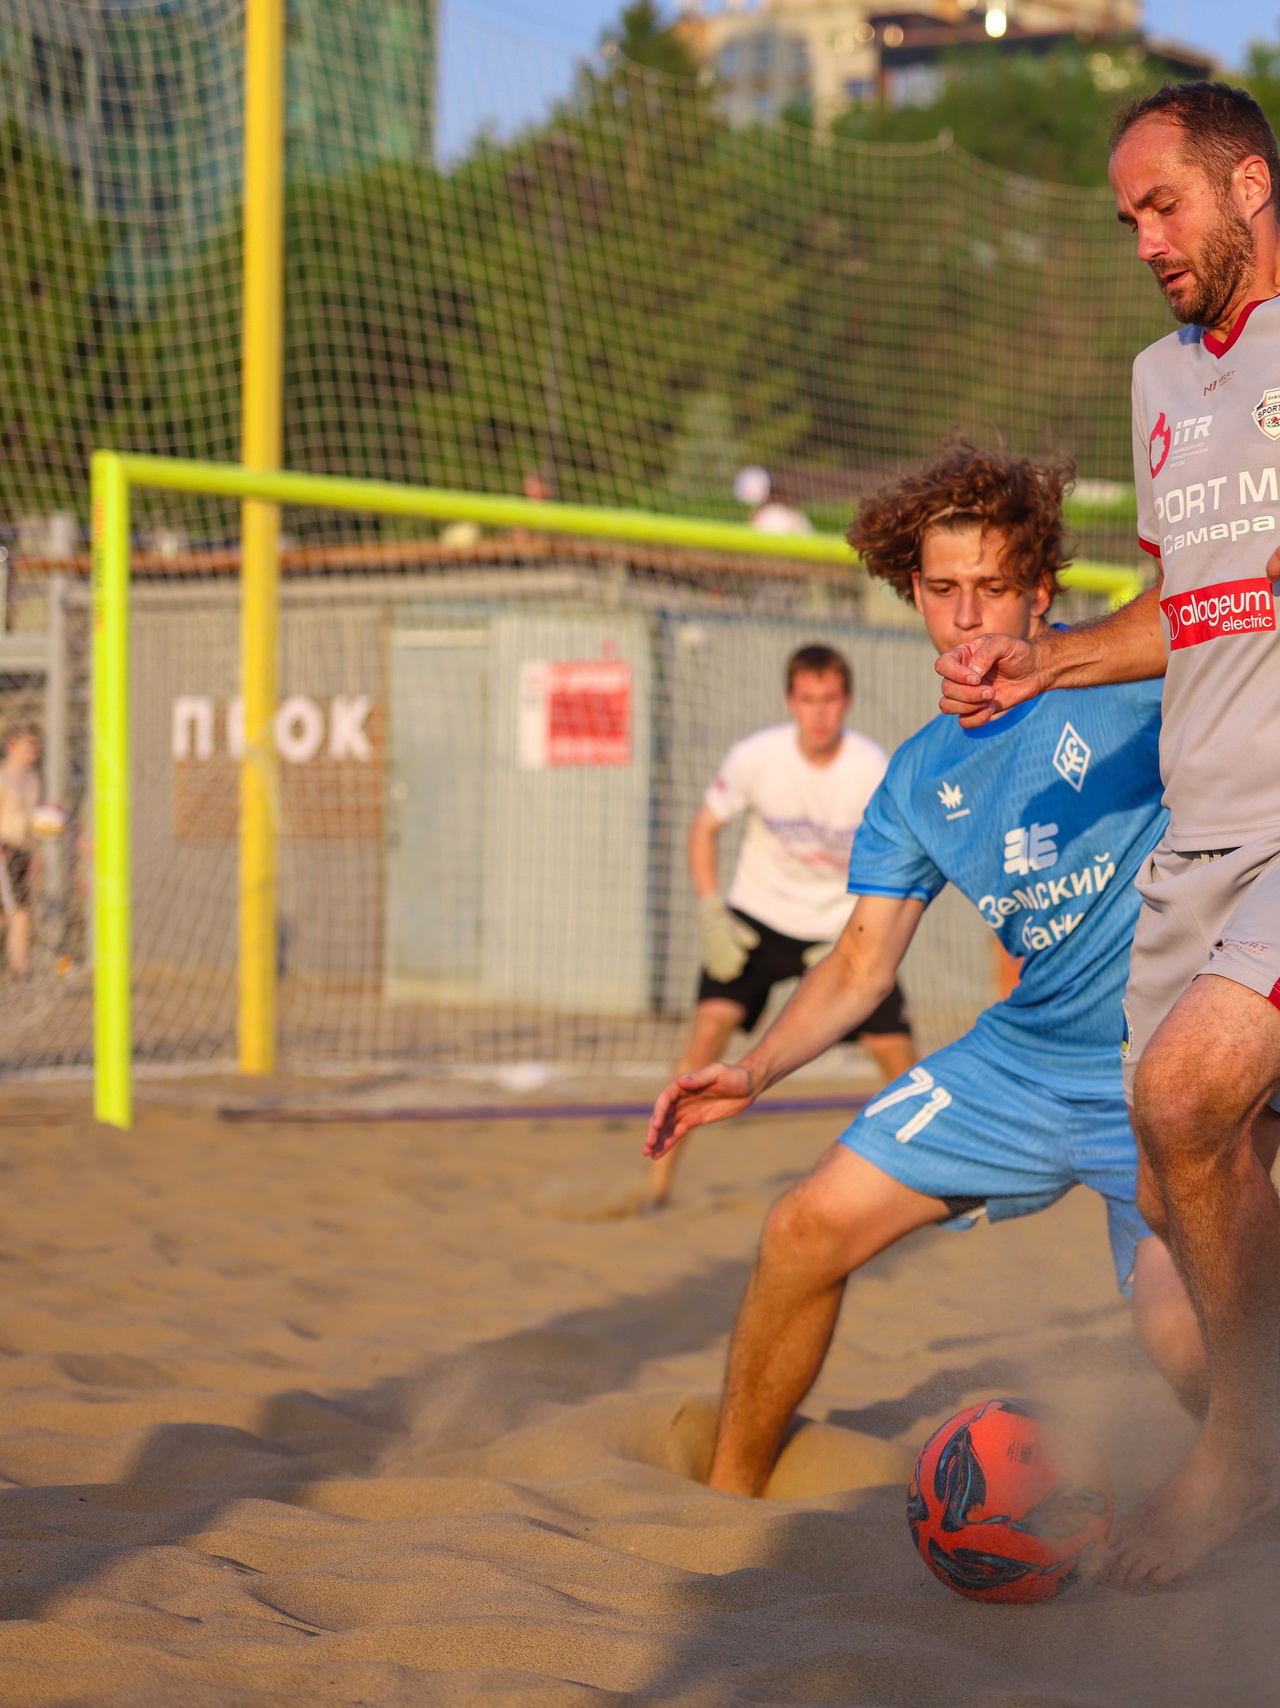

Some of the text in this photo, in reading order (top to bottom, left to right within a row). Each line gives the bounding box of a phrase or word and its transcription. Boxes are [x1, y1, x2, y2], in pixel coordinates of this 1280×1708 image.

[1154, 476, 1228, 524] PORT
[1163, 515, 1276, 557] Самара
[1179, 589, 1271, 627] alageum
[1221, 613, 1273, 632] electric
[978, 852, 1116, 930] Земский
[864, 1066, 953, 1144] 71
